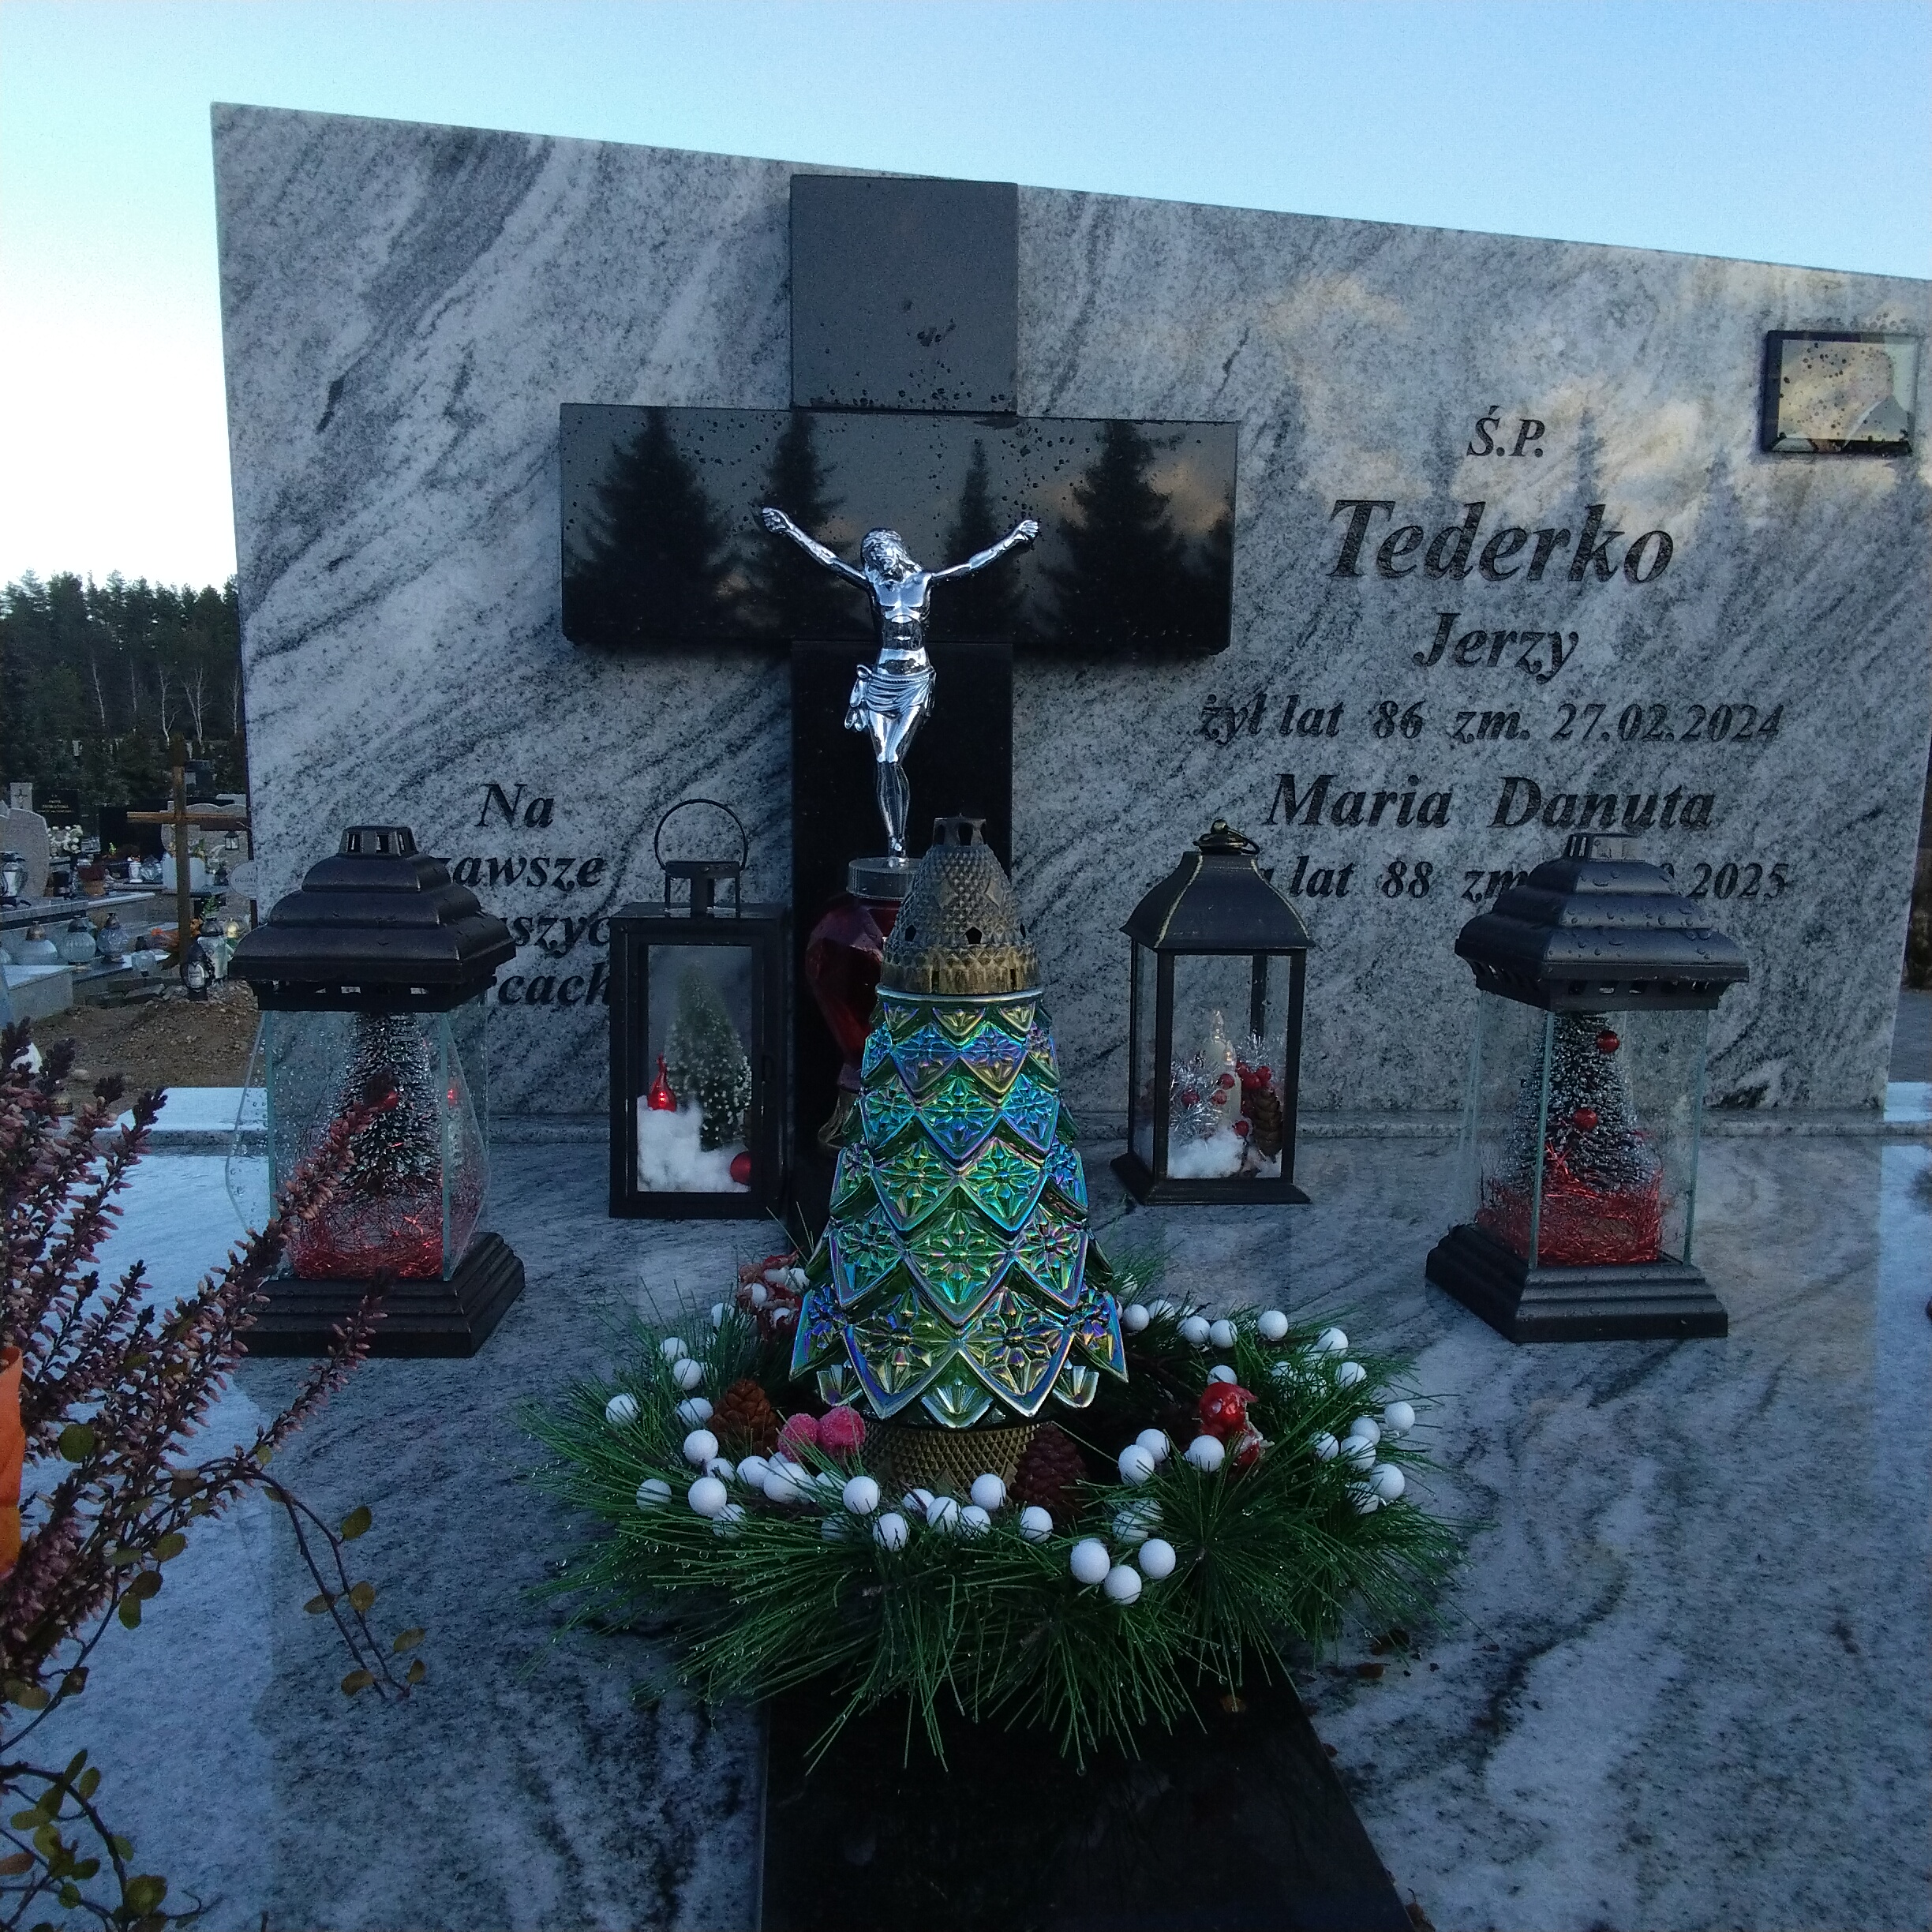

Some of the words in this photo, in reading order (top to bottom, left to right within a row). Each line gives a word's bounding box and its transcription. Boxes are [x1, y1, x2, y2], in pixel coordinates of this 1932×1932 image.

[1466, 405, 1546, 459] Ś.P.
[1325, 499, 1674, 584] Tederko
[1412, 612, 1579, 685] Jerzy
[1193, 694, 1268, 746] żył
[1279, 694, 1345, 738] lat
[1372, 699, 1426, 739] 86
[1454, 709, 1530, 745] zm.
[1549, 703, 1785, 743] 27.02.2024
[474, 783, 554, 829] Na
[1264, 773, 1453, 829] Maria
[1485, 776, 1717, 832] Danuta
[1288, 855, 1355, 898] lat
[1380, 860, 1434, 899] 88
[500, 916, 610, 959] szyc
